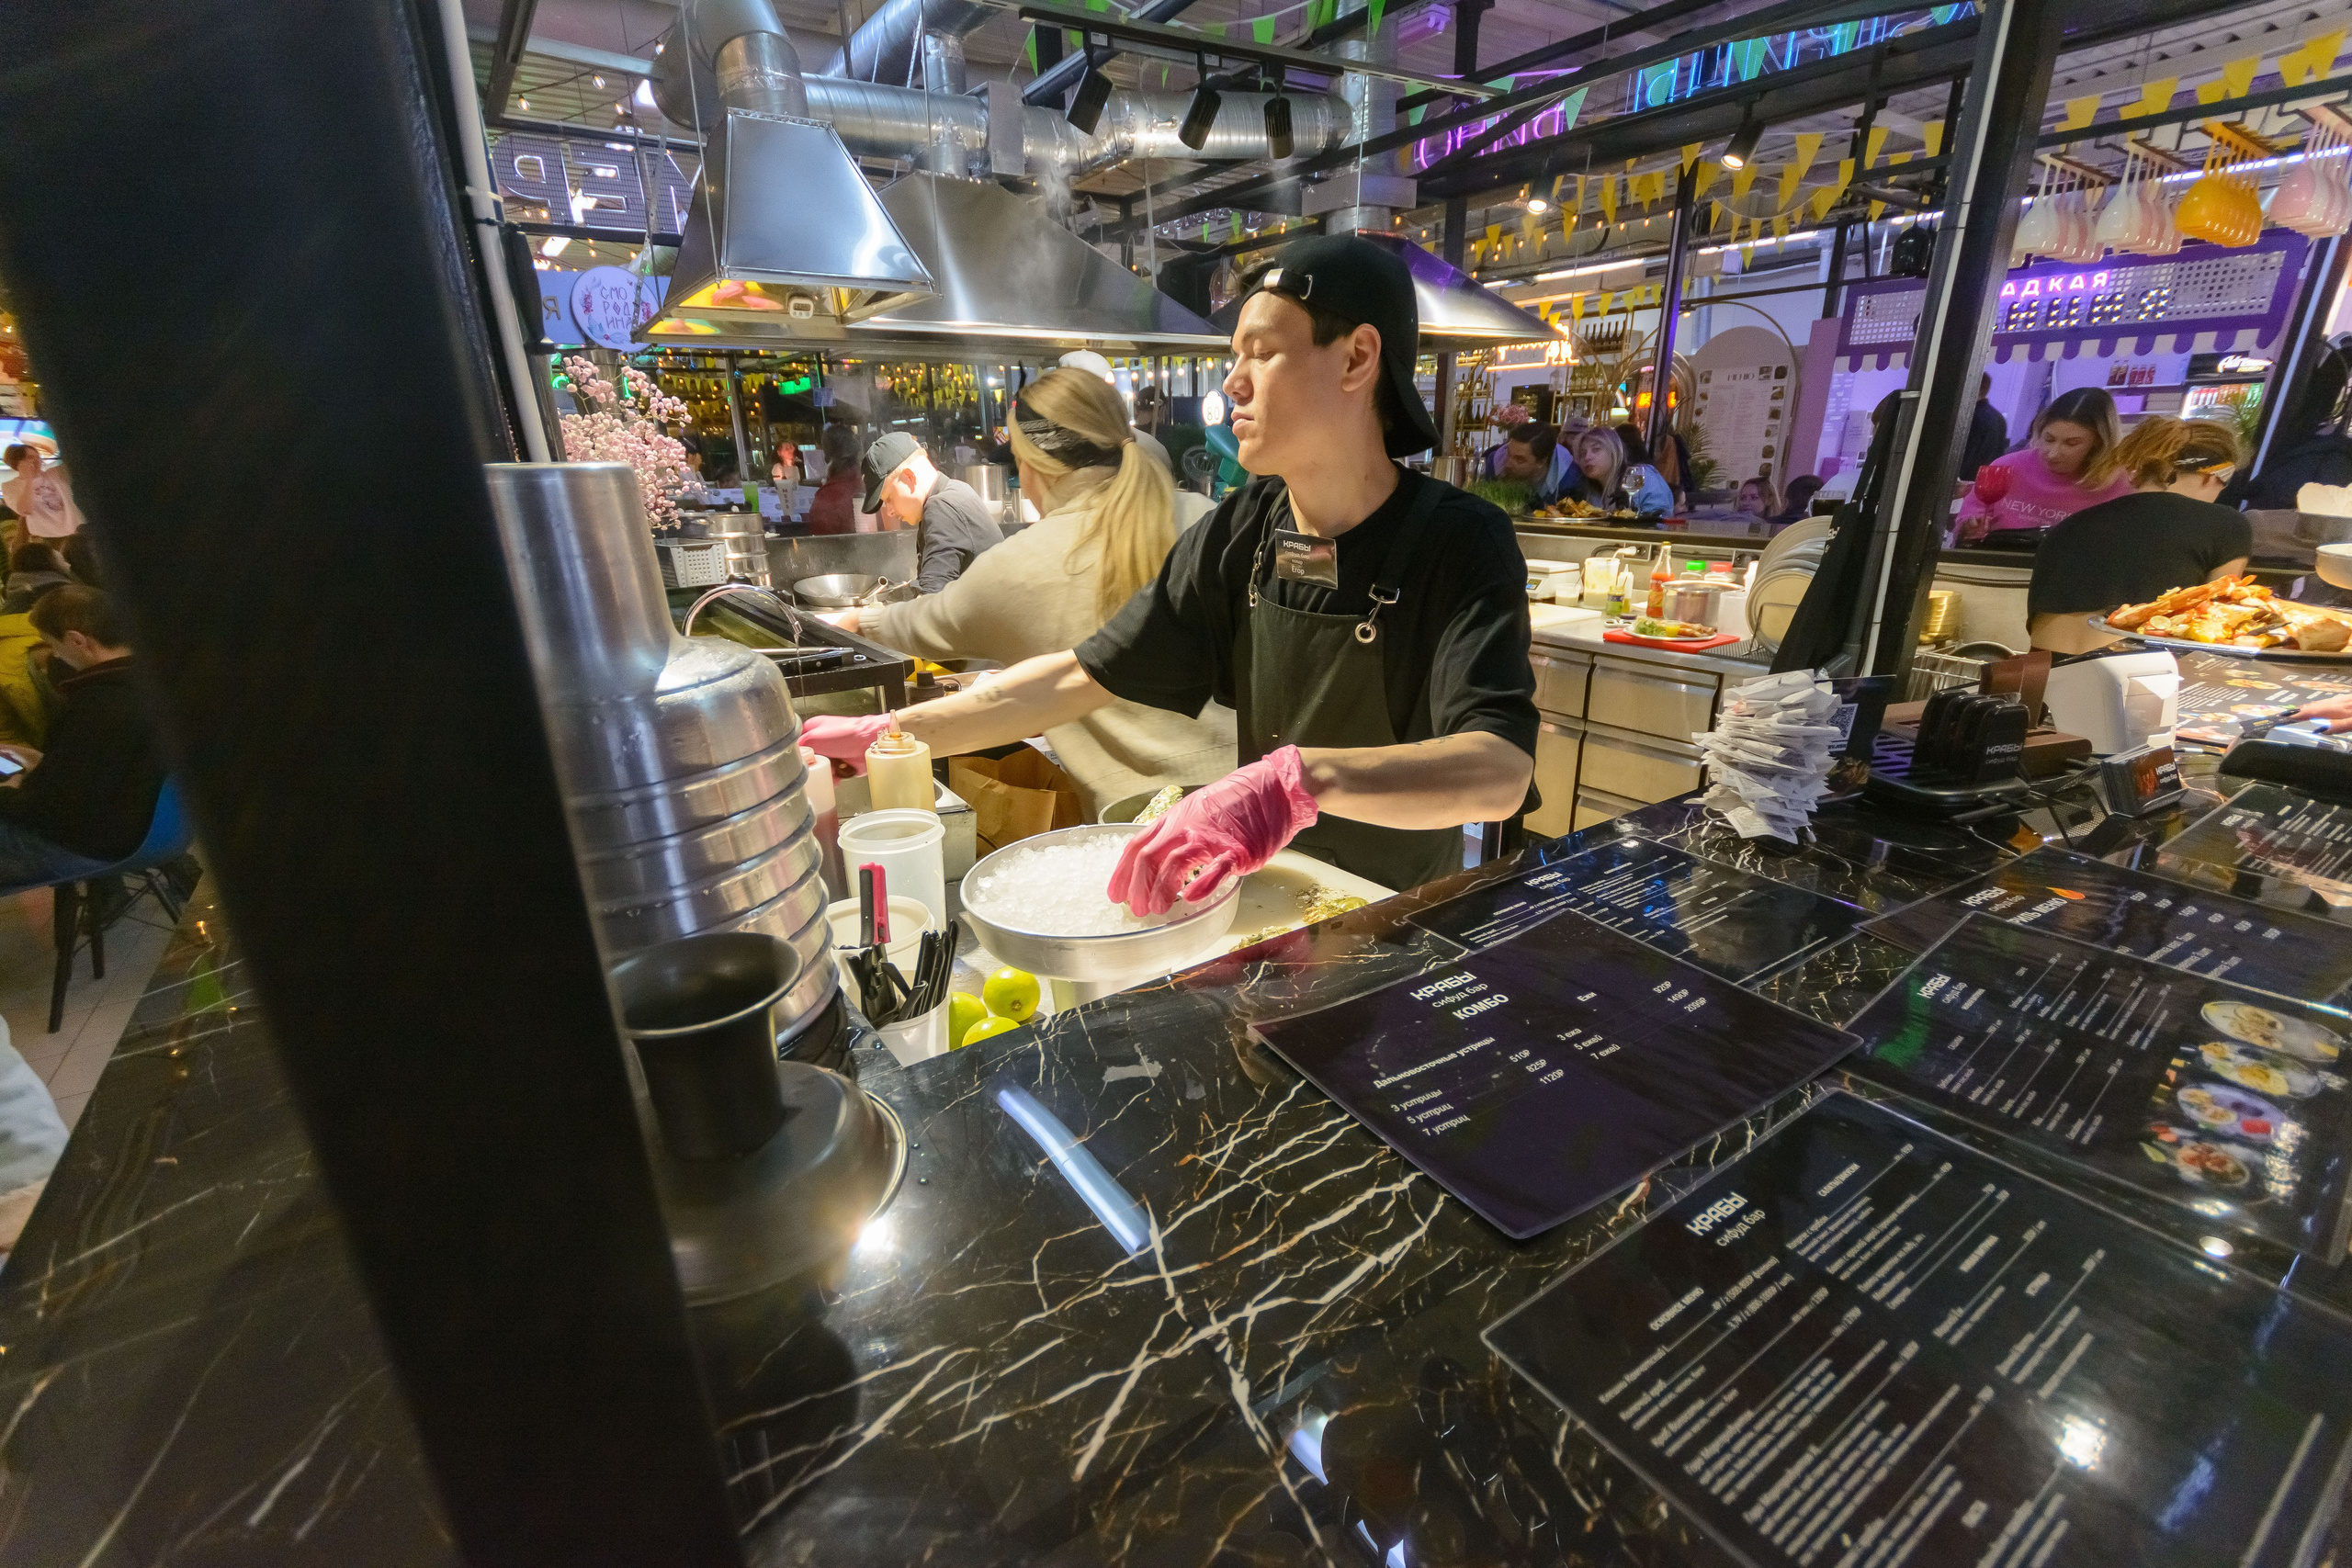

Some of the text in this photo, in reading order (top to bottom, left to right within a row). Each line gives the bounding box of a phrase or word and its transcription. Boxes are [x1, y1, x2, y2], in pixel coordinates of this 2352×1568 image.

[600, 286, 628, 300] СМО
[1992, 288, 2171, 331] НЦИЯ
[2001, 498, 2037, 513] NEW
[2039, 507, 2073, 521] YOR
[1283, 540, 1311, 551] КРАБЫ
[1292, 565, 1305, 575] Егор
[1986, 743, 2023, 754] КРАБЫ
[2154, 761, 2177, 775] КРАБЫ
[1524, 872, 1563, 886] КРАБЫ
[1960, 886, 2007, 907] КРАБЫ
[2030, 897, 2068, 912] МЕНЮ
[1409, 971, 1477, 1000] КРАБЫ
[1432, 982, 1488, 1008] сифуд бар
[1917, 973, 1951, 998] КРАБЫ
[1453, 994, 1510, 1021] КОМБО
[1455, 1035, 1496, 1058] устрицы
[1573, 1043, 1583, 1051] 5
[1590, 1052, 1600, 1060] 7
[1390, 1089, 1443, 1113] 3 устрицы
[1407, 1102, 1454, 1125] 5 устриц
[1422, 1113, 1471, 1137] 7 устриц
[1685, 1191, 1748, 1237] КРАБЫ
[1714, 1208, 1766, 1248] сифуд бар
